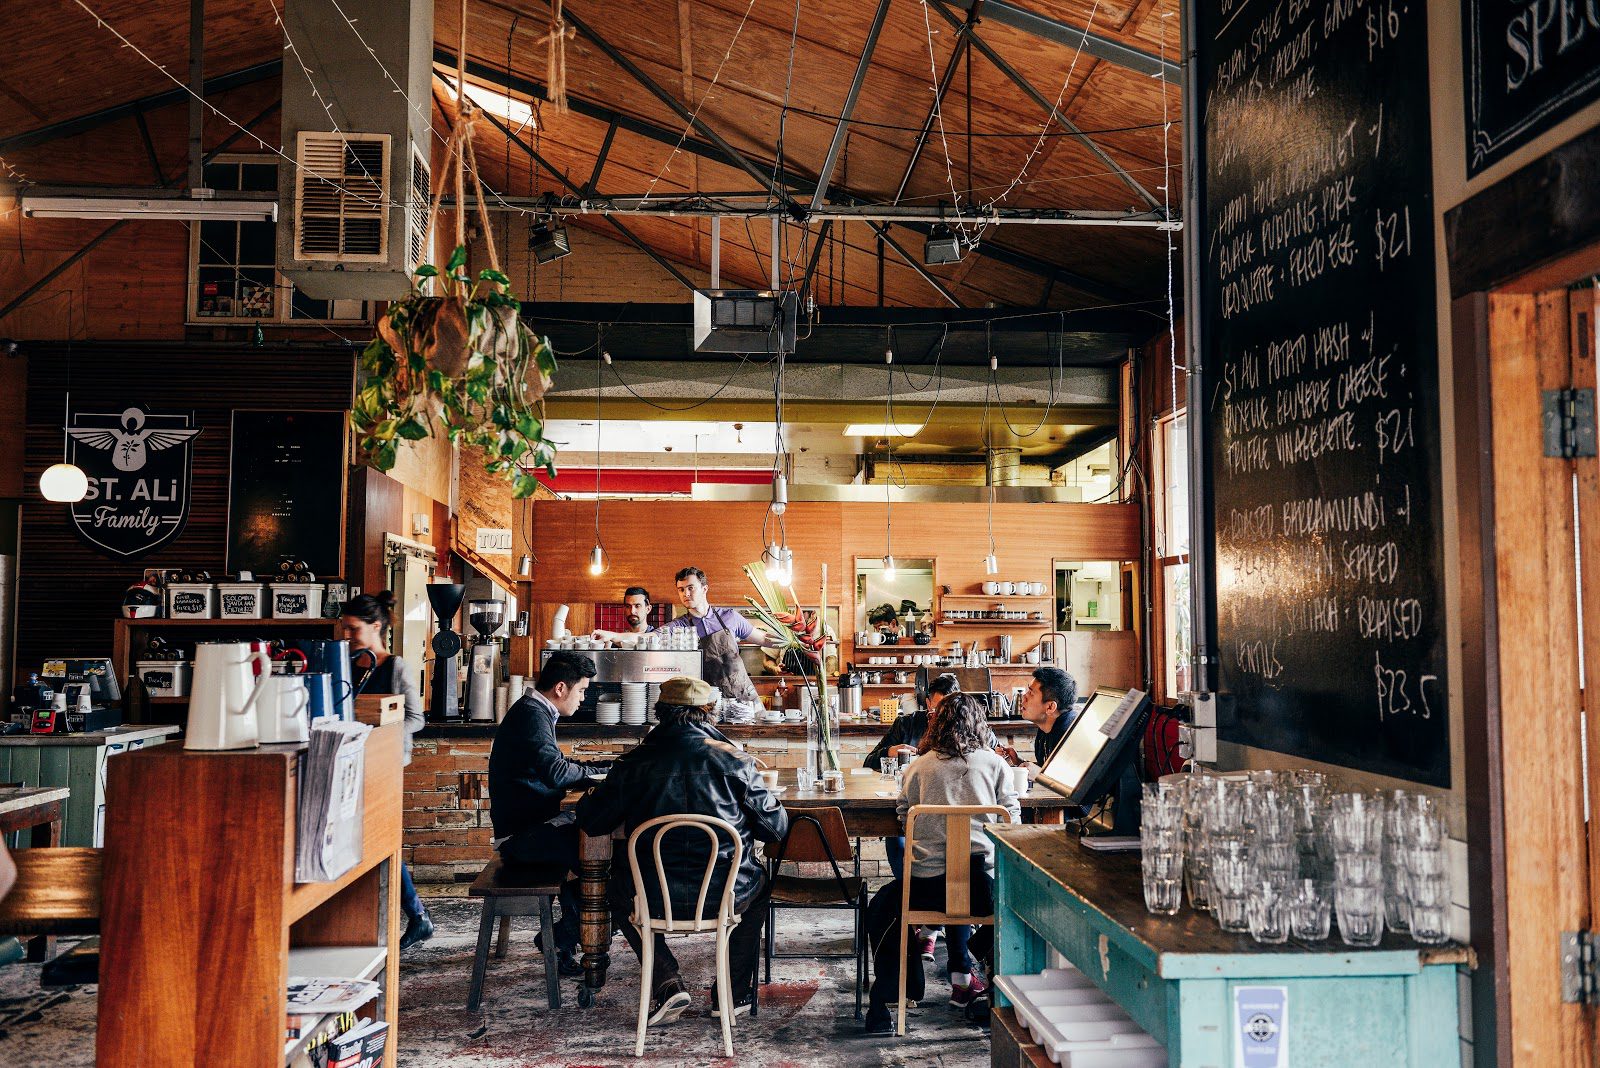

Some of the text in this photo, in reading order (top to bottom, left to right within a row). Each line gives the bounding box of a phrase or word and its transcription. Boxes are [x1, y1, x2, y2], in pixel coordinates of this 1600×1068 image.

[1251, 2, 1283, 62] STYLE
[1219, 194, 1247, 244] HAM
[1220, 229, 1257, 280] BLACK
[1323, 175, 1357, 227] PORK
[1375, 205, 1411, 272] $21
[1290, 237, 1325, 287] FRIED
[1224, 361, 1238, 400] ST
[1267, 334, 1307, 385] POTATO
[1313, 321, 1350, 370] HASH
[1277, 377, 1331, 426] GRUYERE
[1337, 353, 1392, 411] CHEESE
[1227, 437, 1271, 481] TRUFFLE
[84, 476, 122, 501] ST.
[94, 505, 161, 537] Family
[1283, 491, 1386, 537] BARRAMUNDI
[1341, 540, 1399, 585] SEARED
[1356, 594, 1423, 643] BRAISED
[1373, 650, 1438, 723] $23.5
